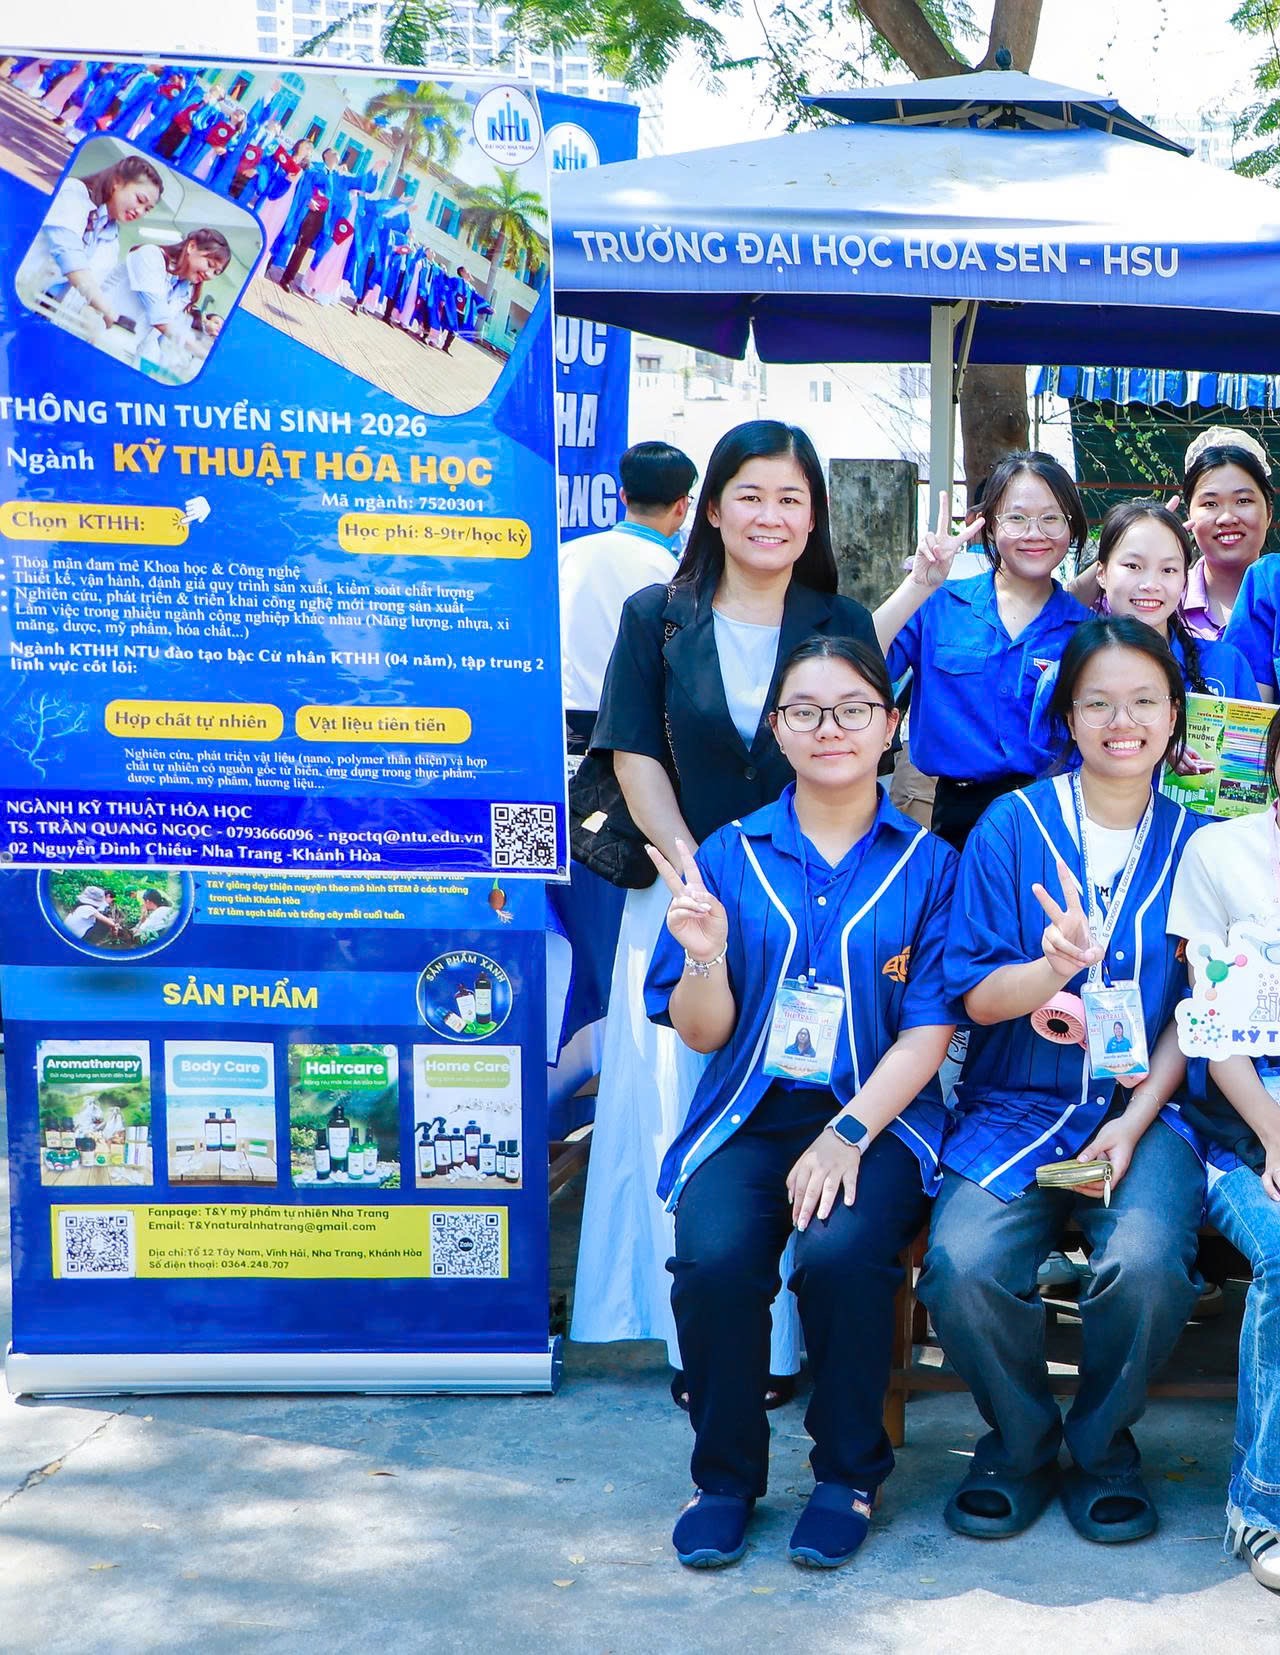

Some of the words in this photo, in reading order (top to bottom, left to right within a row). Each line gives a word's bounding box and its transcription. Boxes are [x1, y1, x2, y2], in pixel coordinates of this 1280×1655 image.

[491, 124, 528, 142] NTU
[573, 224, 726, 264] TRƯỜNG
[735, 231, 801, 273] ĐẠI
[811, 233, 894, 275] HỌC
[904, 235, 987, 273] HOA
[995, 240, 1068, 274] SEN
[1102, 243, 1180, 279] HSU
[556, 316, 608, 374] ỌC
[0, 393, 108, 425] THÔNG
[115, 401, 167, 427] TIN
[174, 398, 271, 432] TUYỂN
[280, 409, 351, 435] SINH
[361, 413, 427, 438] 2026
[556, 391, 599, 448] HA
[7, 447, 95, 475] Ngành
[113, 437, 167, 474] KỸ
[173, 442, 306, 486] THUẬT
[315, 445, 402, 482] HÓA
[411, 454, 493, 492] HỌC
[321, 493, 349, 508] Mã
[353, 494, 413, 512] ngành:
[419, 497, 484, 511] 7520301
[11, 511, 67, 532] Chọn
[79, 513, 145, 532] KTHH:
[344, 523, 380, 541] Học
[385, 523, 419, 542] phí:
[423, 525, 504, 545] 8-9tr/học
[53, 557, 82, 570] mãn
[86, 557, 115, 570] đam
[119, 560, 140, 572] mê
[144, 560, 180, 573] Khoa
[184, 562, 208, 576] học
[212, 562, 224, 576] &
[228, 563, 264, 580] Công
[268, 565, 301, 580] nghệ
[80, 574, 104, 588] vận
[108, 574, 145, 588] hành,
[148, 576, 181, 589] đánh
[186, 577, 206, 592] giá
[209, 580, 234, 594] quy
[238, 579, 270, 592] trình
[436, 584, 475, 602] lượng
[10, 641, 65, 658] Ngành
[70, 643, 119, 657] KTHH
[124, 645, 160, 658] NTU
[164, 646, 194, 660] đào
[198, 648, 223, 664] tạo
[228, 648, 254, 664] bậc
[286, 650, 326, 664] nhân
[330, 652, 380, 665] KTHH
[384, 652, 409, 668] (04
[413, 654, 457, 670] năm),
[460, 656, 486, 672] tập
[490, 656, 532, 672] trung
[536, 658, 544, 670] 2
[48, 660, 79, 675] vực
[115, 711, 151, 729] Hợp
[155, 710, 192, 727] chất
[196, 714, 215, 732] tự
[219, 714, 268, 730] nhiên
[308, 716, 338, 734] Vật
[342, 716, 374, 734] liệu
[378, 717, 410, 732] tiên
[6, 798, 74, 815] NGÀNH
[78, 798, 102, 816] KỸ
[106, 797, 166, 820] THUẬT
[170, 800, 210, 818] HÓA
[214, 804, 253, 822] HỌC
[7, 821, 34, 834] TS.
[36, 816, 87, 836] TRẦN
[90, 821, 158, 838] QUANG
[161, 824, 213, 840] NGỌC
[226, 826, 314, 842] 0793666096
[328, 830, 484, 846] ngoctq@ntu.edu.vn
[8, 841, 28, 855] 02
[32, 839, 96, 859] Nguyễn
[100, 840, 142, 856] Đình
[202, 844, 234, 858] Nha
[236, 846, 284, 863] Trang
[350, 848, 382, 863] Hòa
[479, 956, 508, 984] XANH
[162, 974, 225, 1006] SẢN
[231, 978, 318, 1009] PHẨM
[1231, 1025, 1260, 1044] KỸ
[46, 1058, 140, 1072] Aromatherapy
[181, 1060, 220, 1076] Body
[224, 1061, 261, 1074] Care
[306, 1061, 385, 1076] Haircare
[425, 1060, 470, 1073] Home
[474, 1060, 510, 1074] Care
[148, 1208, 202, 1218] Fanpage:
[204, 1208, 228, 1216] T&Y
[230, 1208, 247, 1219] mỹ
[284, 1209, 296, 1220] tự
[298, 1208, 329, 1218] nhiên
[331, 1208, 354, 1218] Nha
[356, 1208, 390, 1220] Trang
[148, 1220, 185, 1231] Email:
[188, 1221, 376, 1233] T&Ynaturalnhatrang@gmail.com
[202, 1248, 214, 1257] 12
[216, 1248, 234, 1259] Tây
[237, 1248, 264, 1259] Nam,
[312, 1249, 332, 1258] Nha
[334, 1249, 366, 1260] Trang,
[368, 1248, 400, 1258] Khánh
[403, 1248, 422, 1258] Hòa
[458, 1240, 474, 1248] Zalo
[164, 1260, 186, 1271] điện
[188, 1260, 219, 1271] thoại:
[221, 1260, 289, 1270] 0364.248.707
